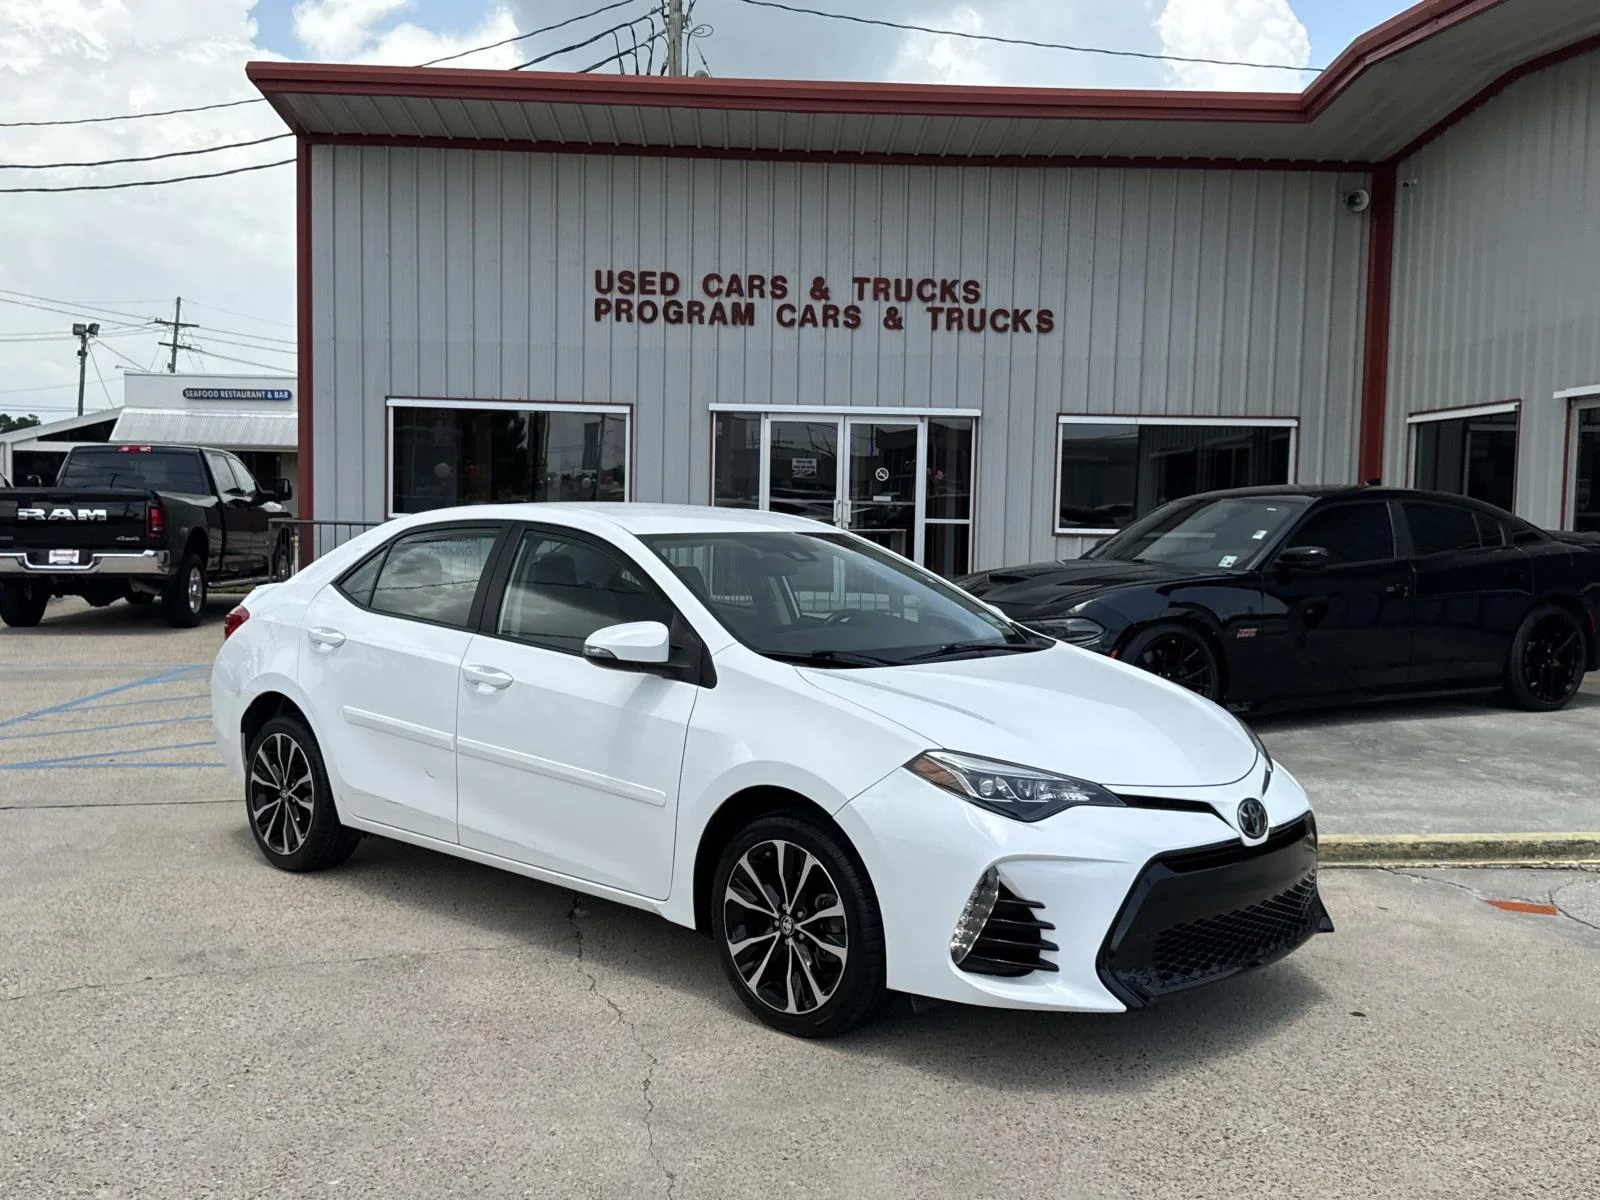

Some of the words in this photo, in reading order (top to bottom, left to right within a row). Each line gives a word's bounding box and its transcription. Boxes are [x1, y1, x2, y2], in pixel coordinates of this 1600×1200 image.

[594, 269, 680, 297] USED
[702, 272, 788, 300] CARS
[809, 276, 831, 302] &
[851, 276, 981, 305] TRUCKS
[594, 297, 755, 327] PROGRAM
[776, 303, 862, 331] CARS
[883, 306, 904, 331] &
[925, 306, 1055, 334] TRUCKS
[185, 389, 219, 398] SEAFOOD
[220, 390, 266, 399] RESTAURANT
[267, 391, 273, 399] &
[274, 391, 289, 399] BAR
[17, 508, 107, 520] RAM
